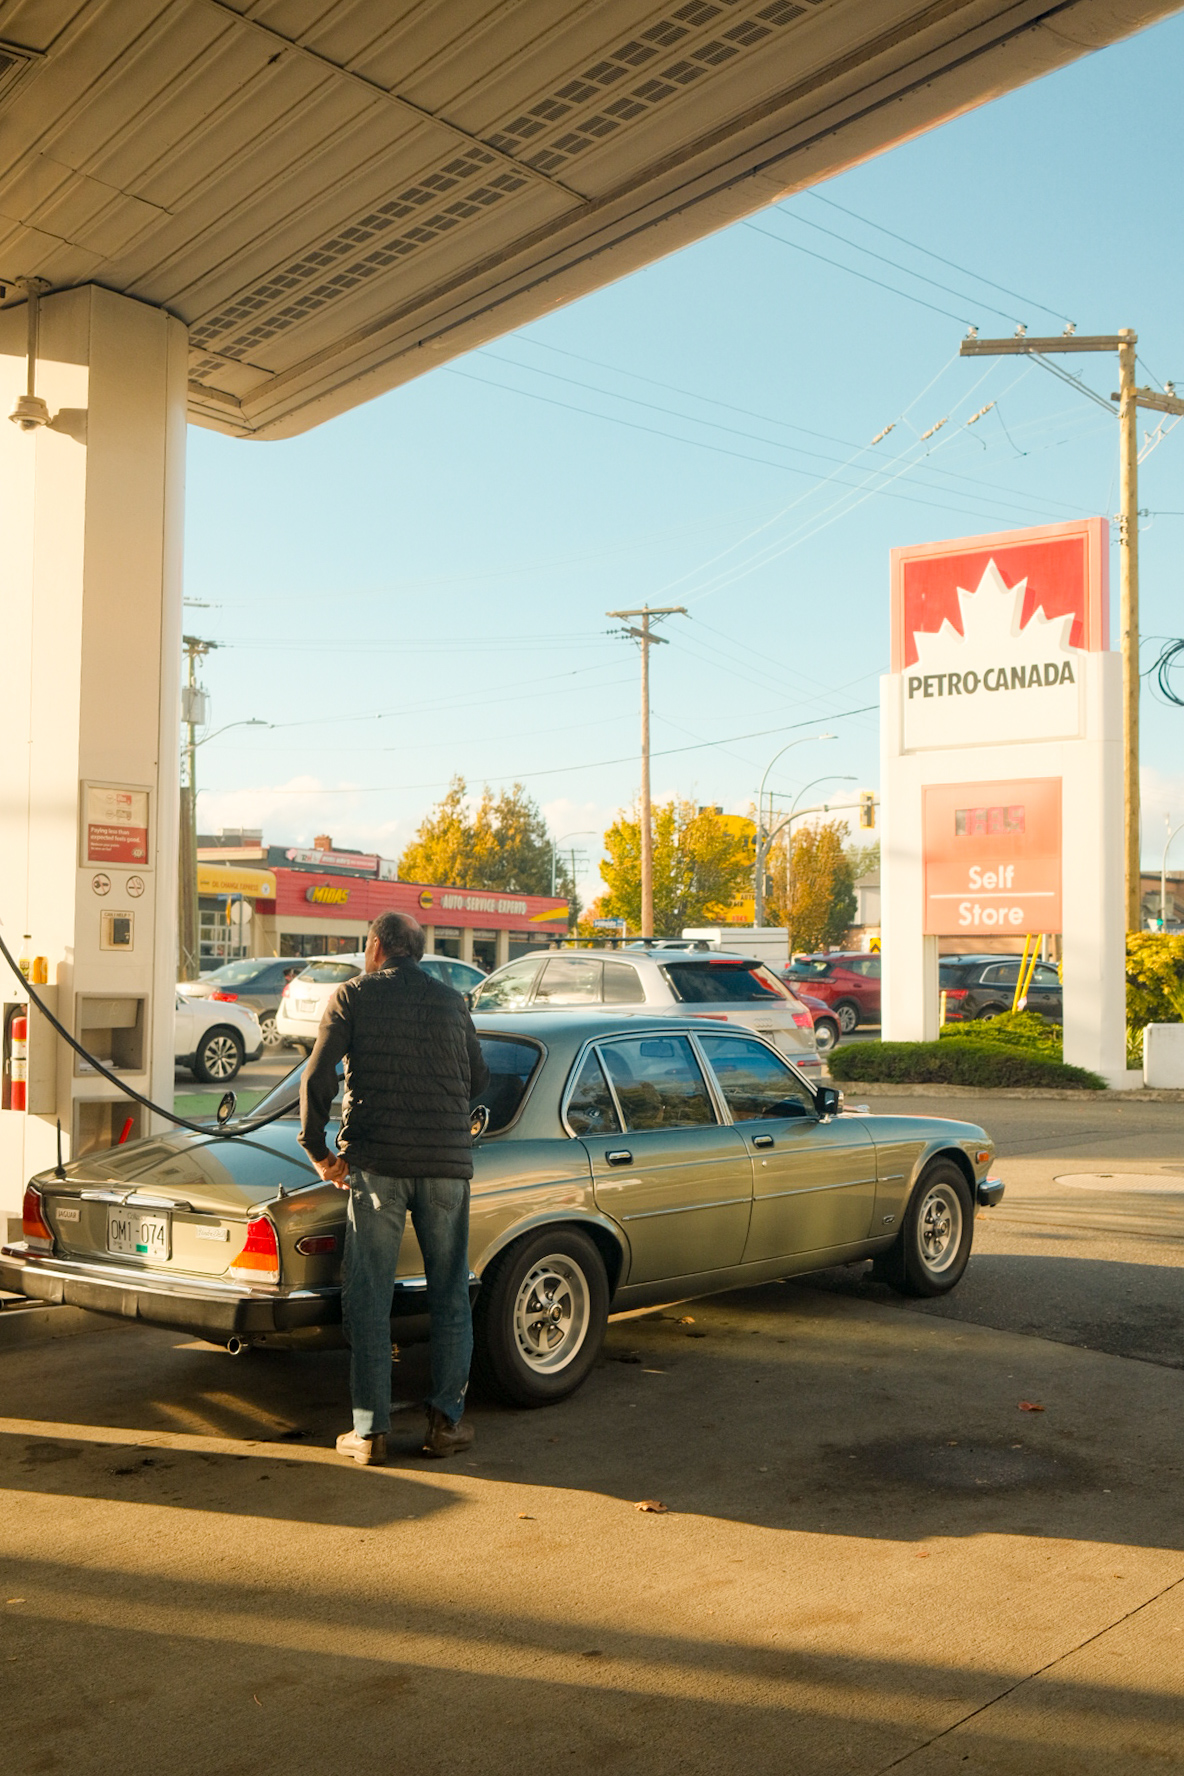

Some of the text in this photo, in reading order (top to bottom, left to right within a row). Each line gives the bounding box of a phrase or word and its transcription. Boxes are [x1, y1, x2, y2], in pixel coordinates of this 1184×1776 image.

[90, 827, 108, 835] Paying
[968, 864, 1015, 890] Self
[220, 881, 239, 890] CHANGE
[240, 883, 259, 892] EXPRESS
[312, 886, 350, 904] MIDAS
[442, 894, 527, 915] AUTO SERVICE EXPERTS
[958, 901, 1025, 926] Store
[58, 1209, 77, 1219] JAGUAR
